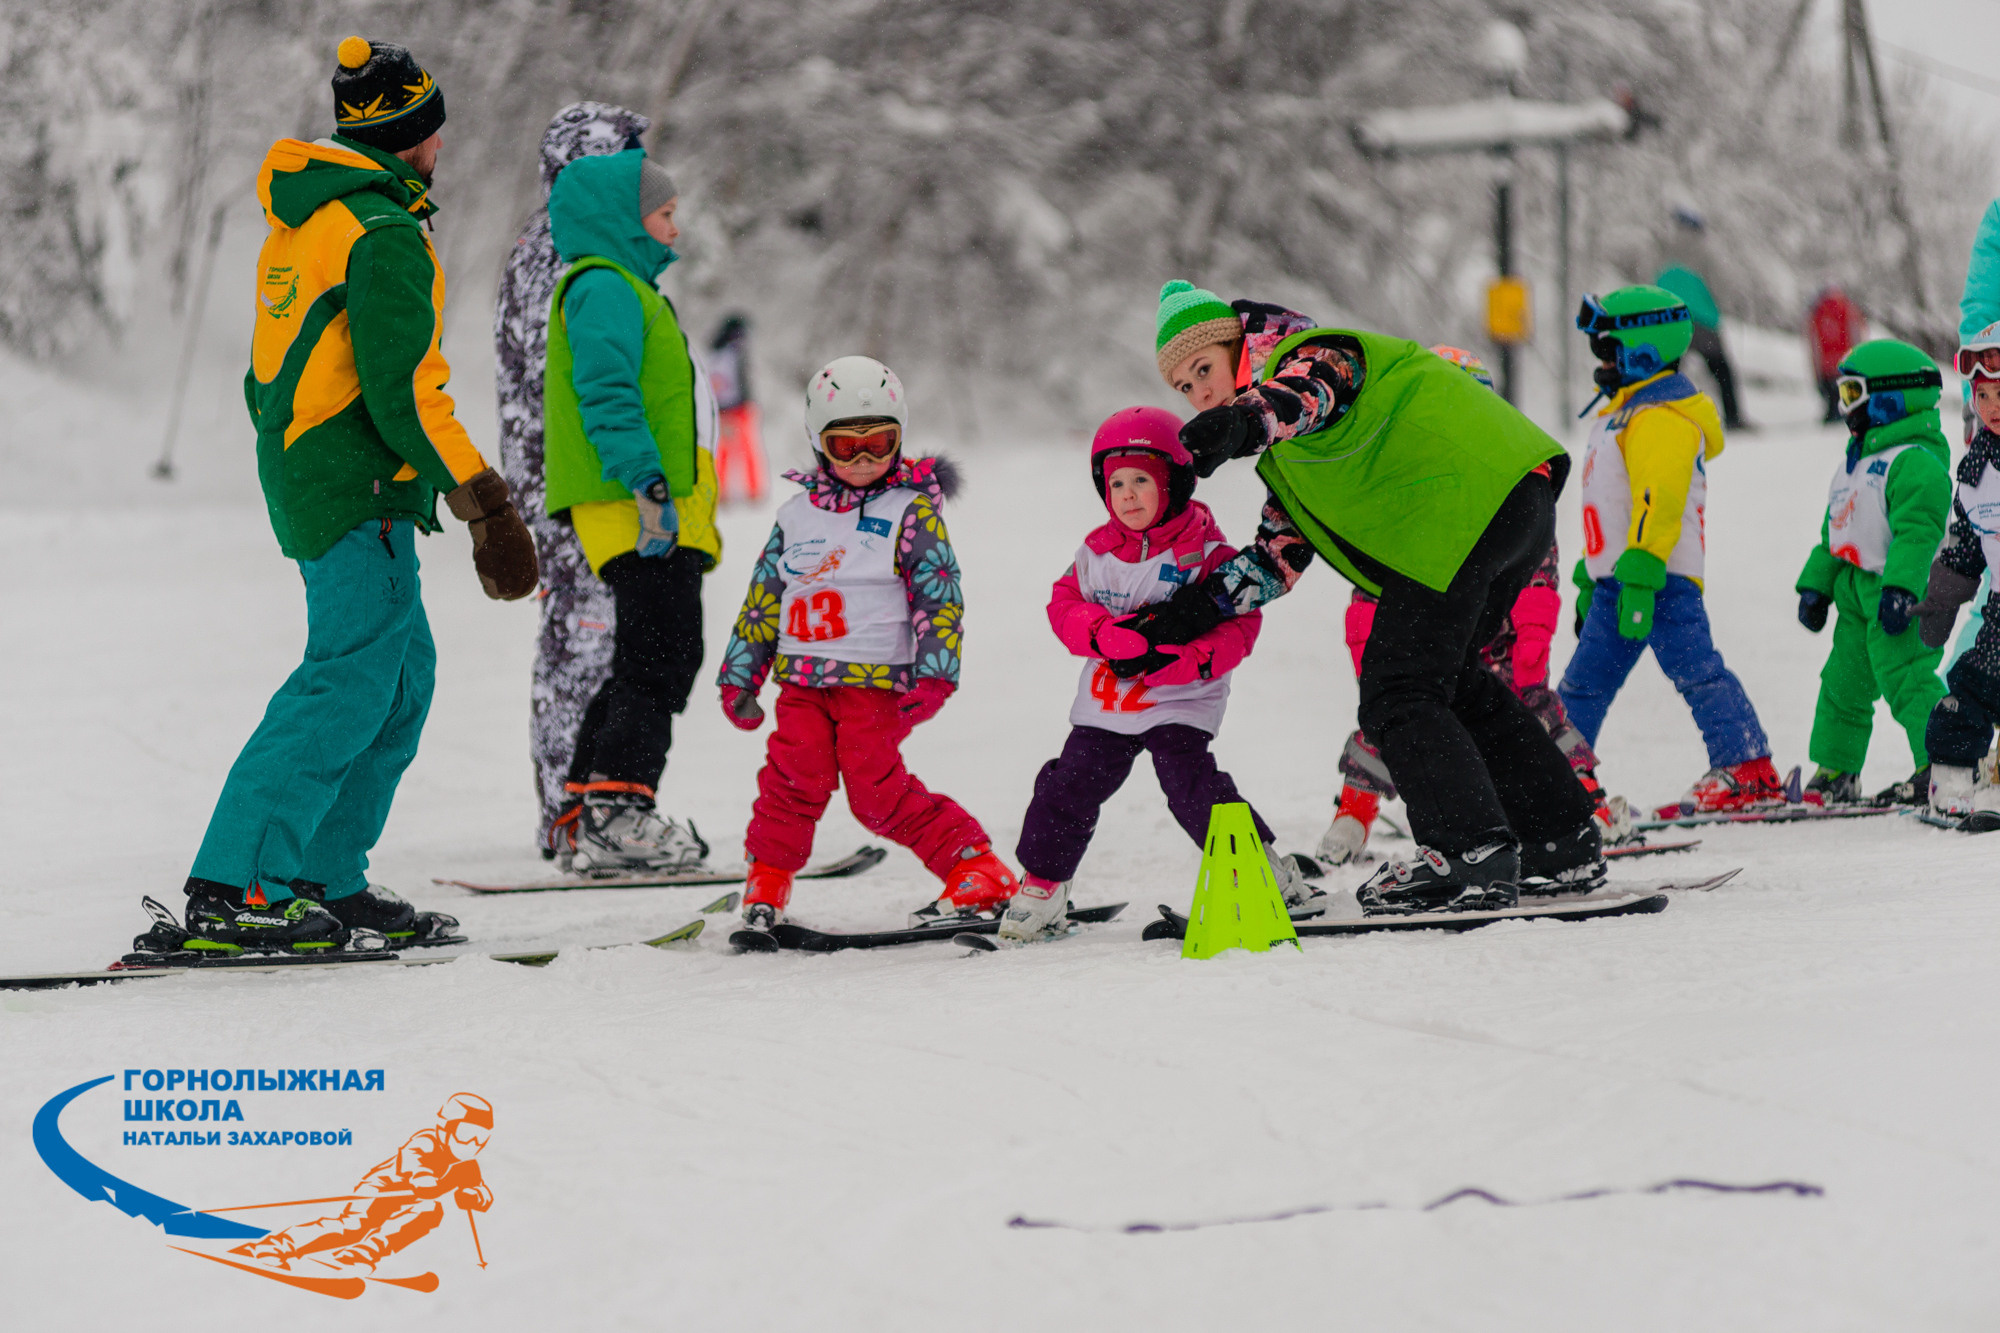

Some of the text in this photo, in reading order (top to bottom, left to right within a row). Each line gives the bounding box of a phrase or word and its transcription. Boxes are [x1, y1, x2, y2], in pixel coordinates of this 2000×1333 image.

[786, 588, 850, 642] 43
[1091, 659, 1158, 714] 42
[234, 911, 290, 927] NORDICA
